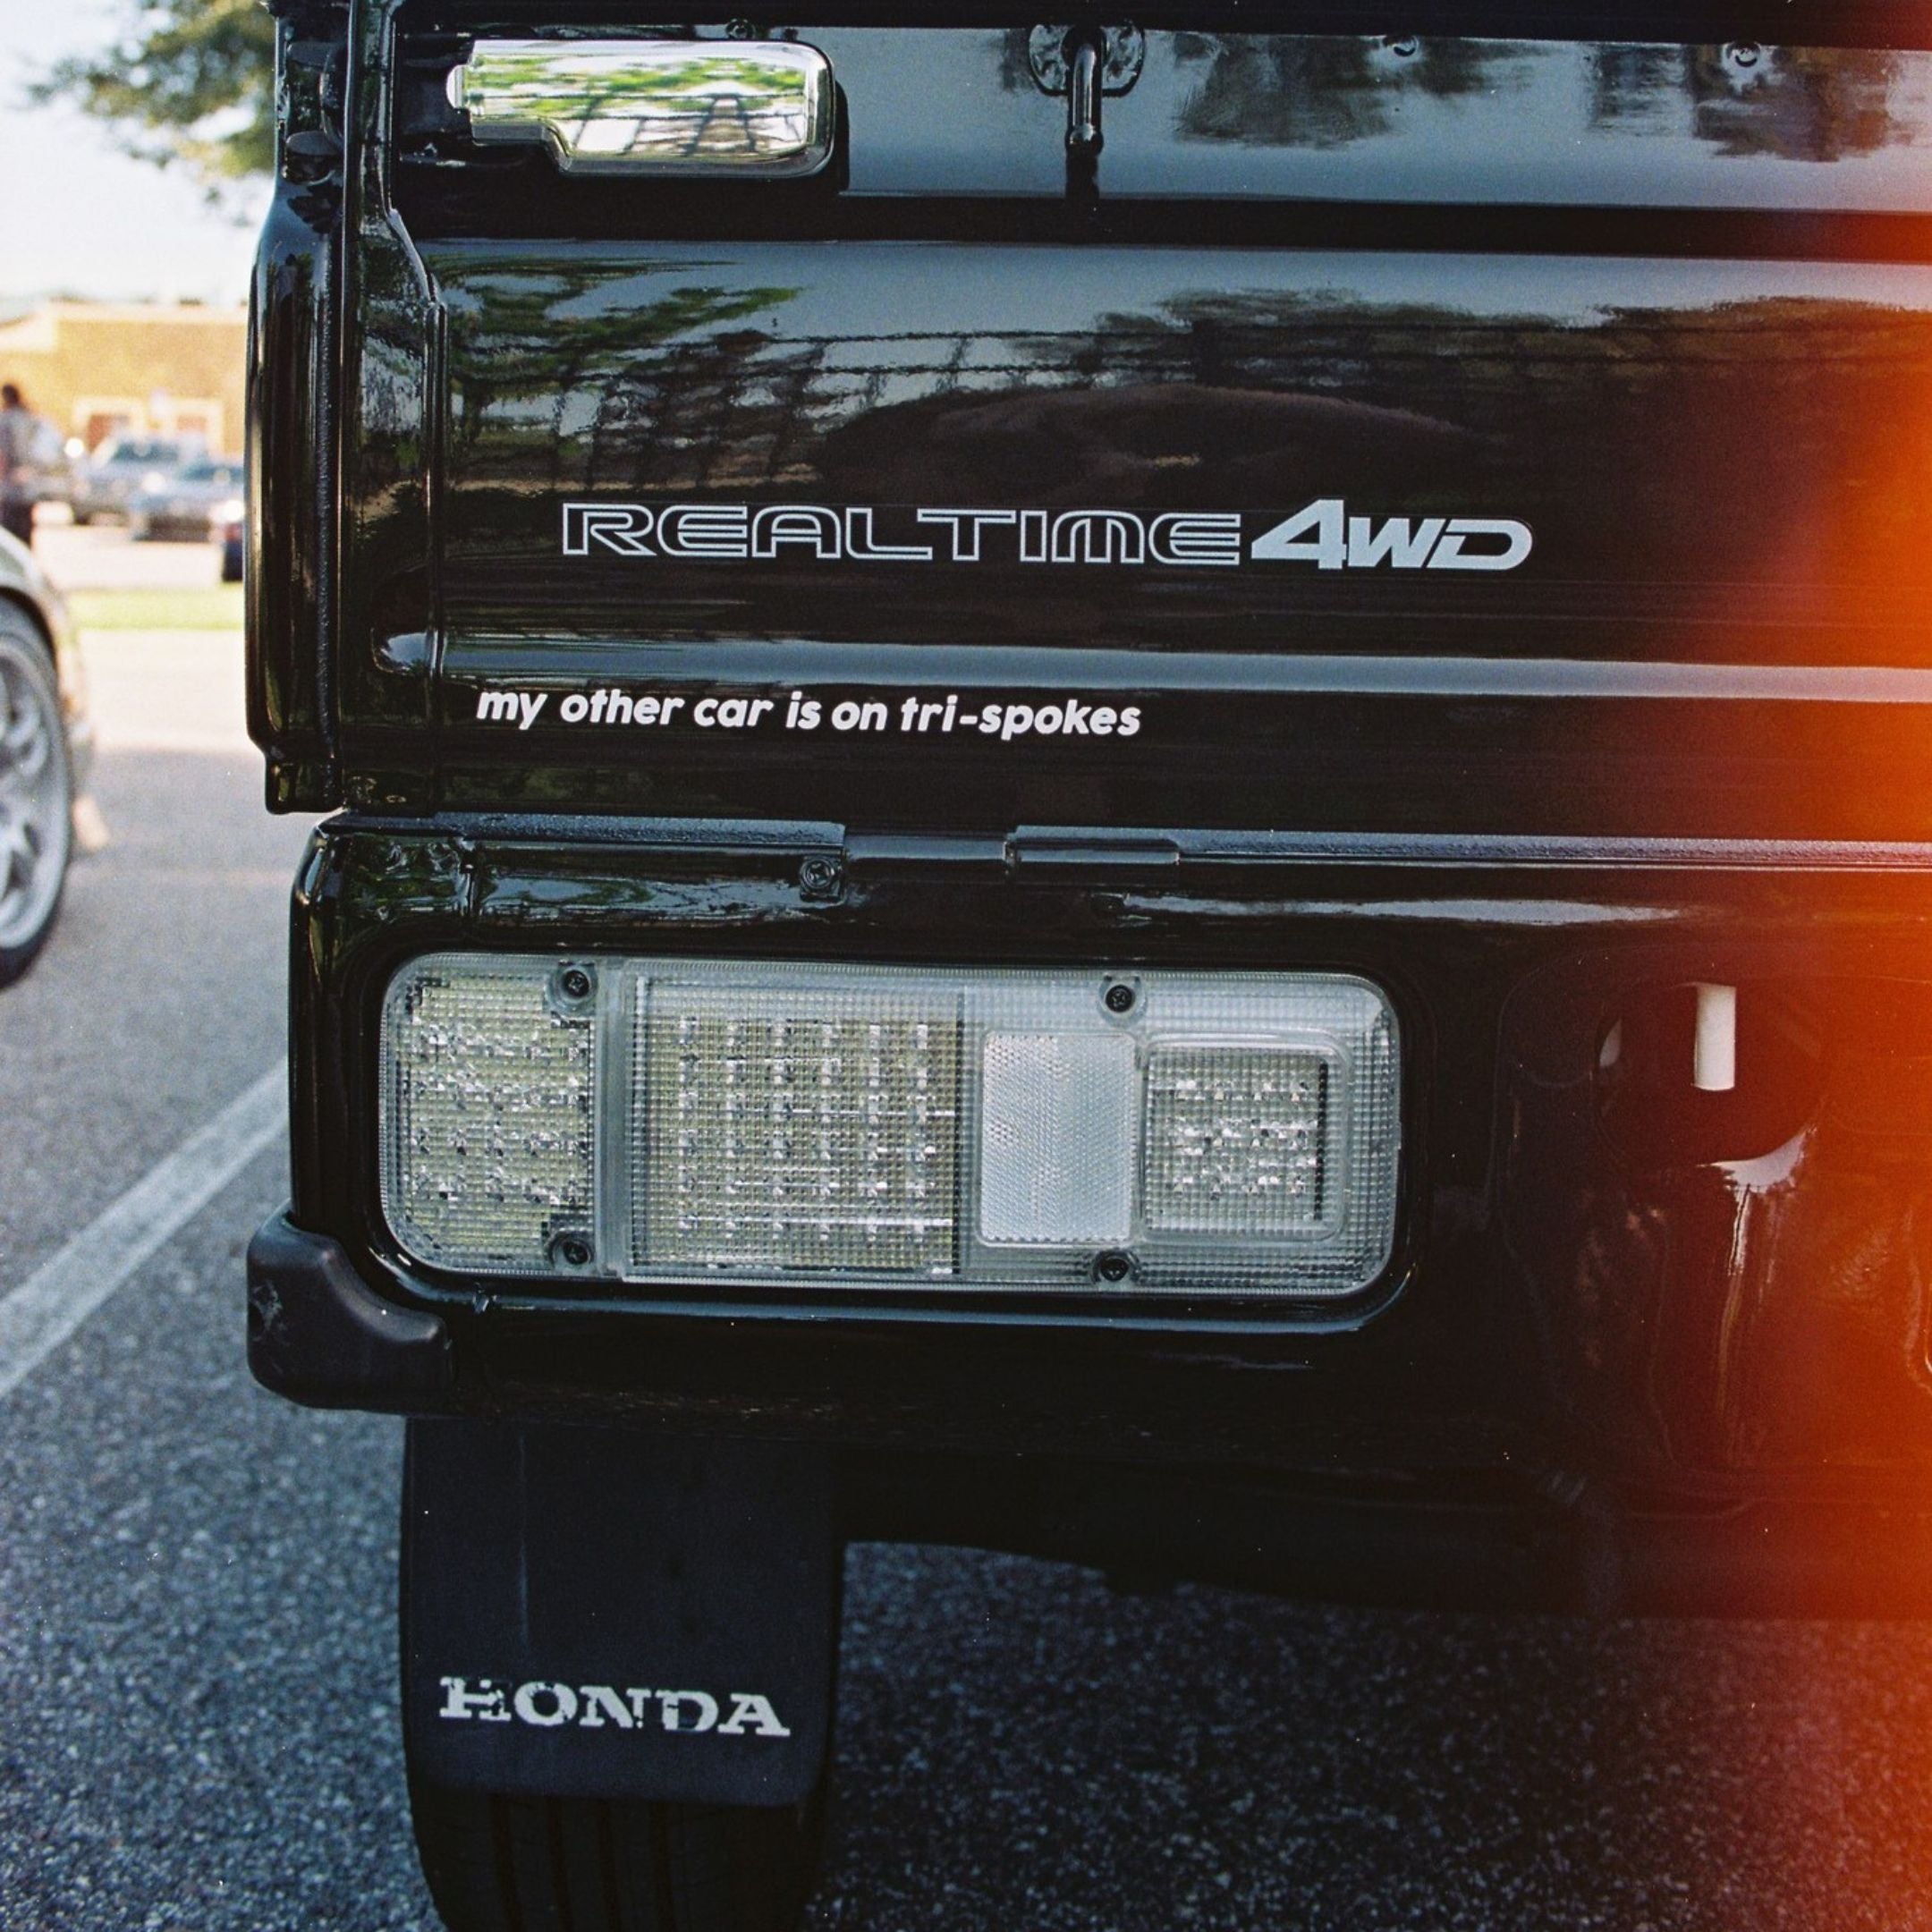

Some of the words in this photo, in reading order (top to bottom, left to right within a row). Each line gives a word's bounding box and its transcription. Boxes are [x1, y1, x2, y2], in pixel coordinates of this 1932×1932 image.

[1250, 499, 1533, 571] 4WD
[476, 691, 547, 731] my
[560, 689, 685, 724] other
[693, 699, 774, 727] car
[785, 691, 822, 730] is
[832, 701, 887, 731] on
[901, 695, 1141, 741] tri-spokes
[439, 1676, 791, 1737] HONDA
